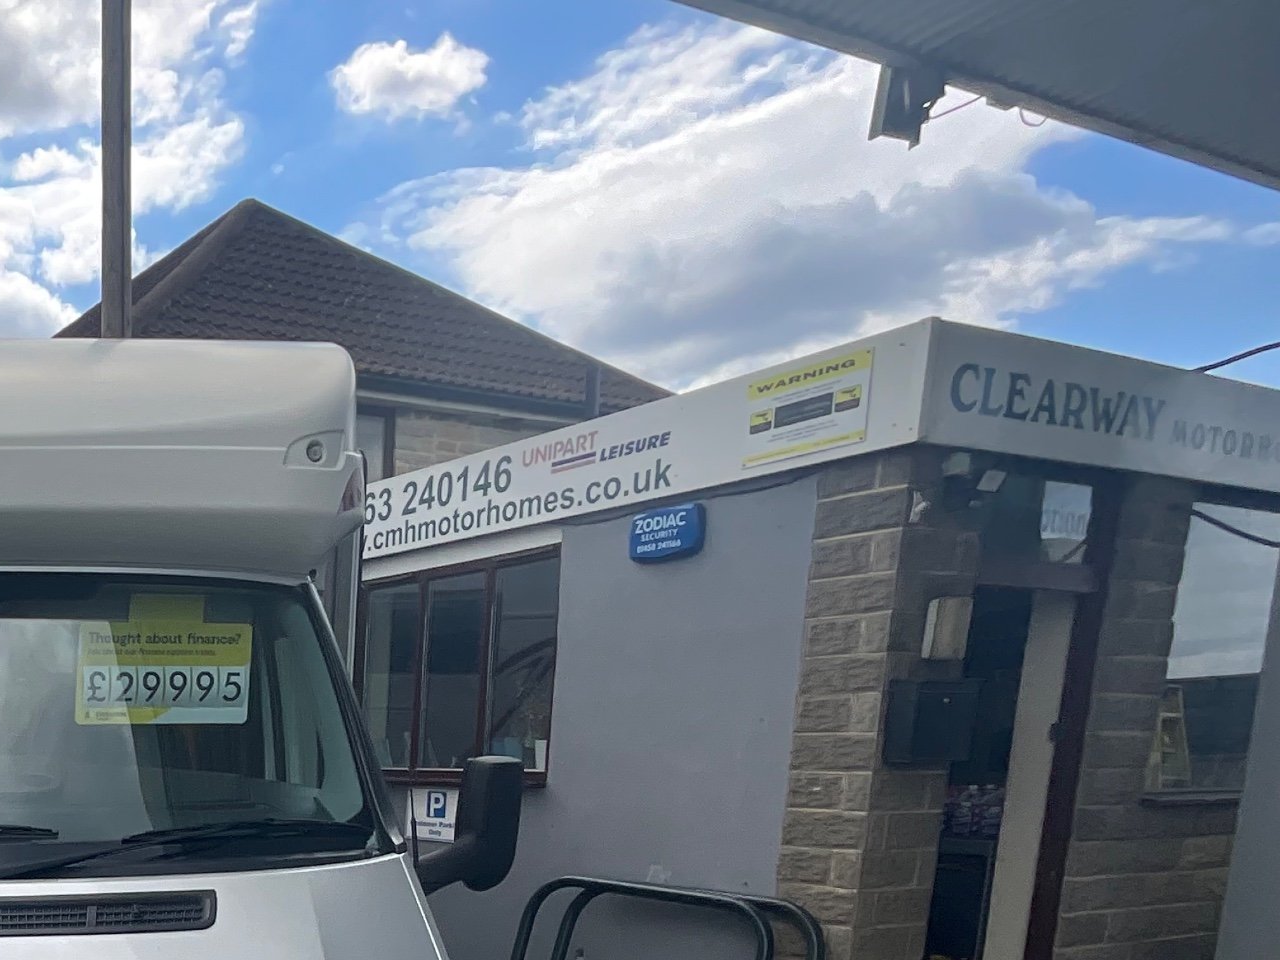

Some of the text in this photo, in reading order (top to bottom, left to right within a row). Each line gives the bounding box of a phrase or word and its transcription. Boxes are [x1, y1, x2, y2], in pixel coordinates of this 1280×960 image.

[757, 359, 856, 393] WARNING
[950, 363, 1166, 442] CLEARWAY
[522, 430, 671, 467] UNIPART LEISURE
[402, 455, 512, 516] 240146
[363, 458, 672, 552] .cmhmotorhomes.co.uk
[635, 512, 686, 534] ZODIAC
[641, 528, 679, 542] SECURITY
[89, 632, 241, 645] Thought about finance?
[87, 671, 241, 702] £29995
[429, 792, 445, 817] P
